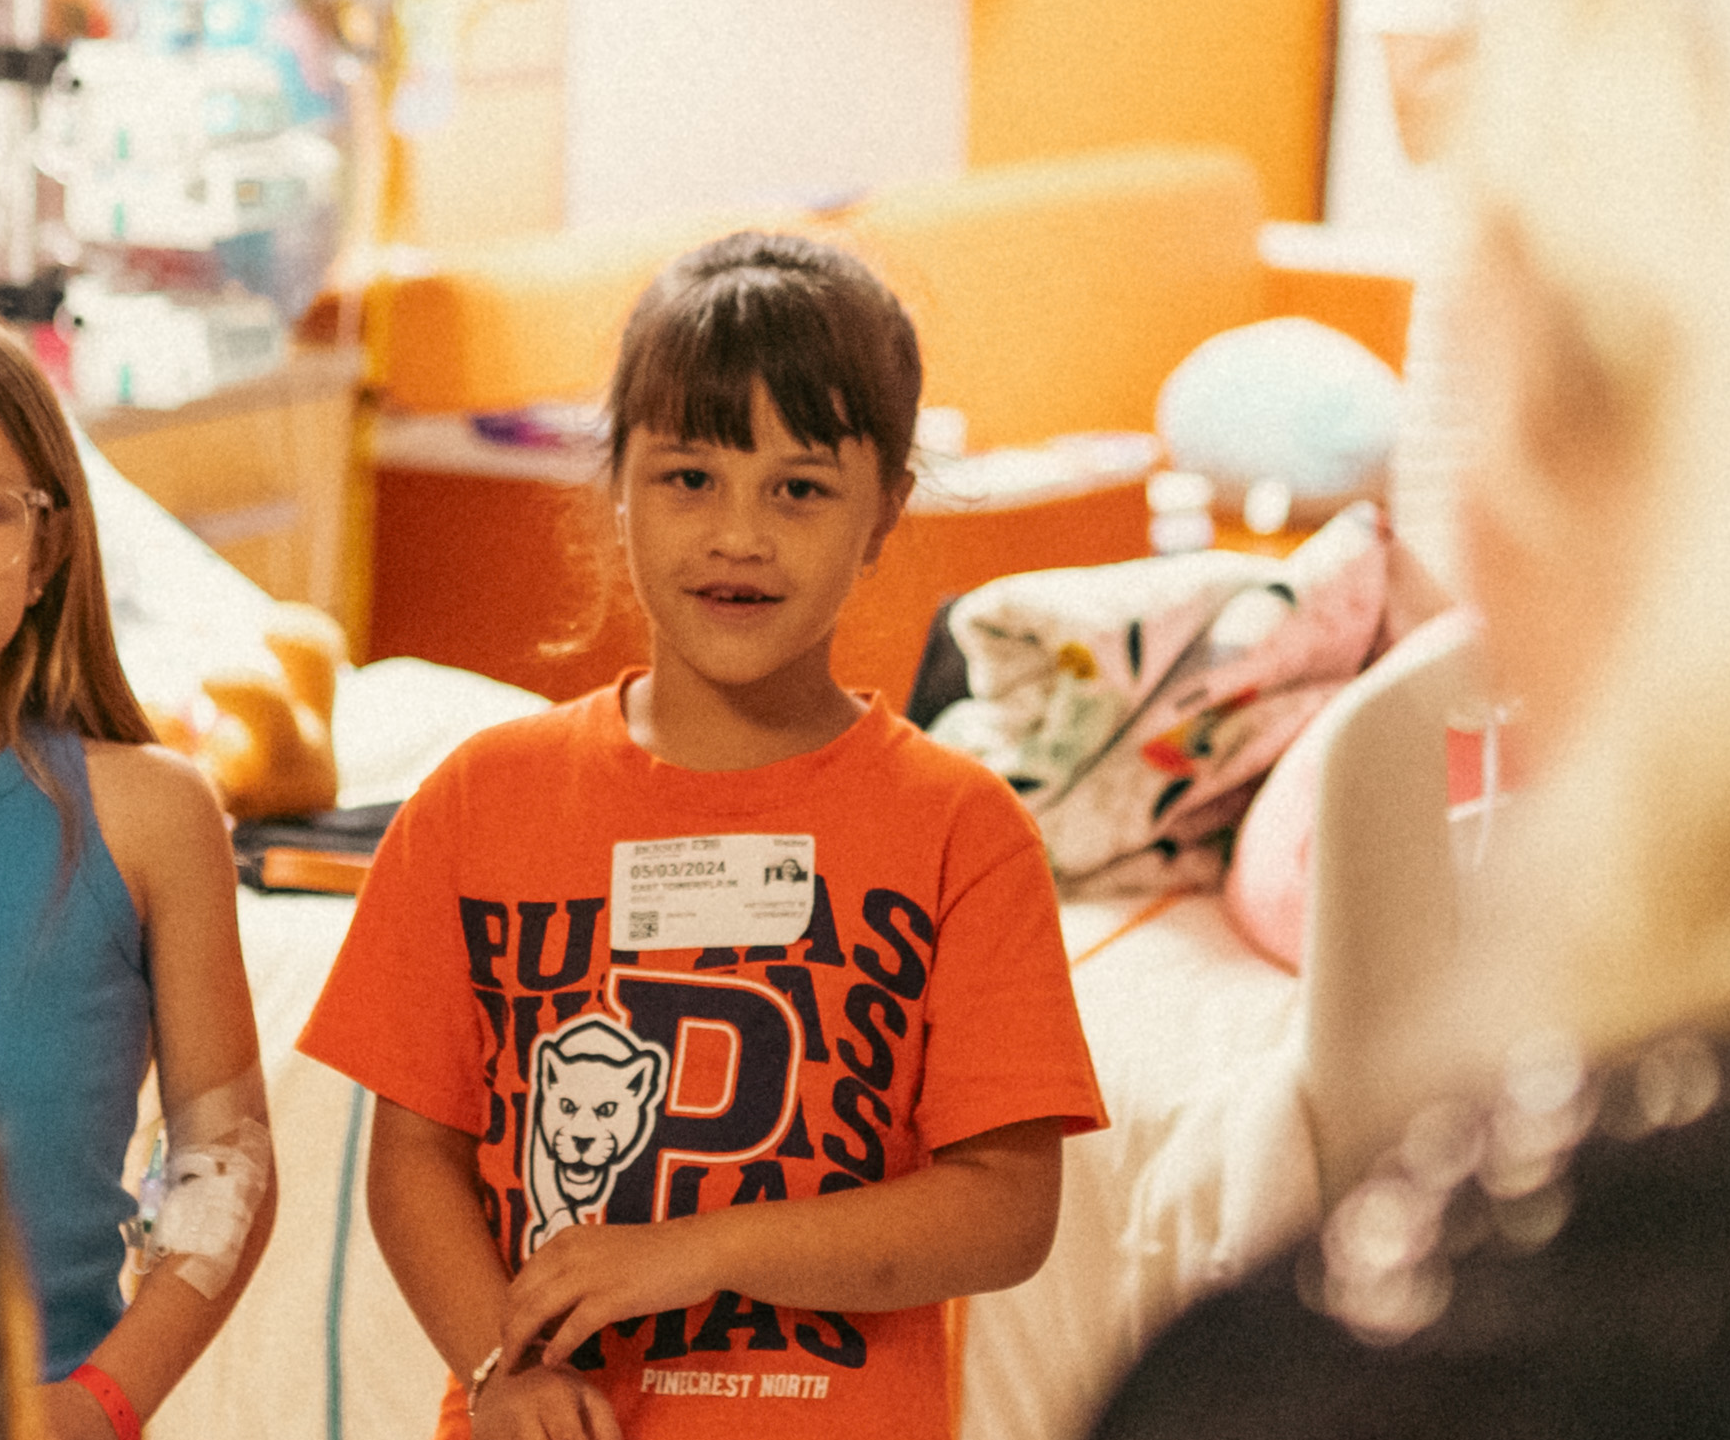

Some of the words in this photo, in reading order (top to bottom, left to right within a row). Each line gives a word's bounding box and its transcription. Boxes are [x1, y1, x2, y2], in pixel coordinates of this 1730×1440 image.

[630, 860, 727, 880] 05/03/2024
[641, 1367, 754, 1399] PINECREST
[758, 1373, 831, 1400] NORTH
